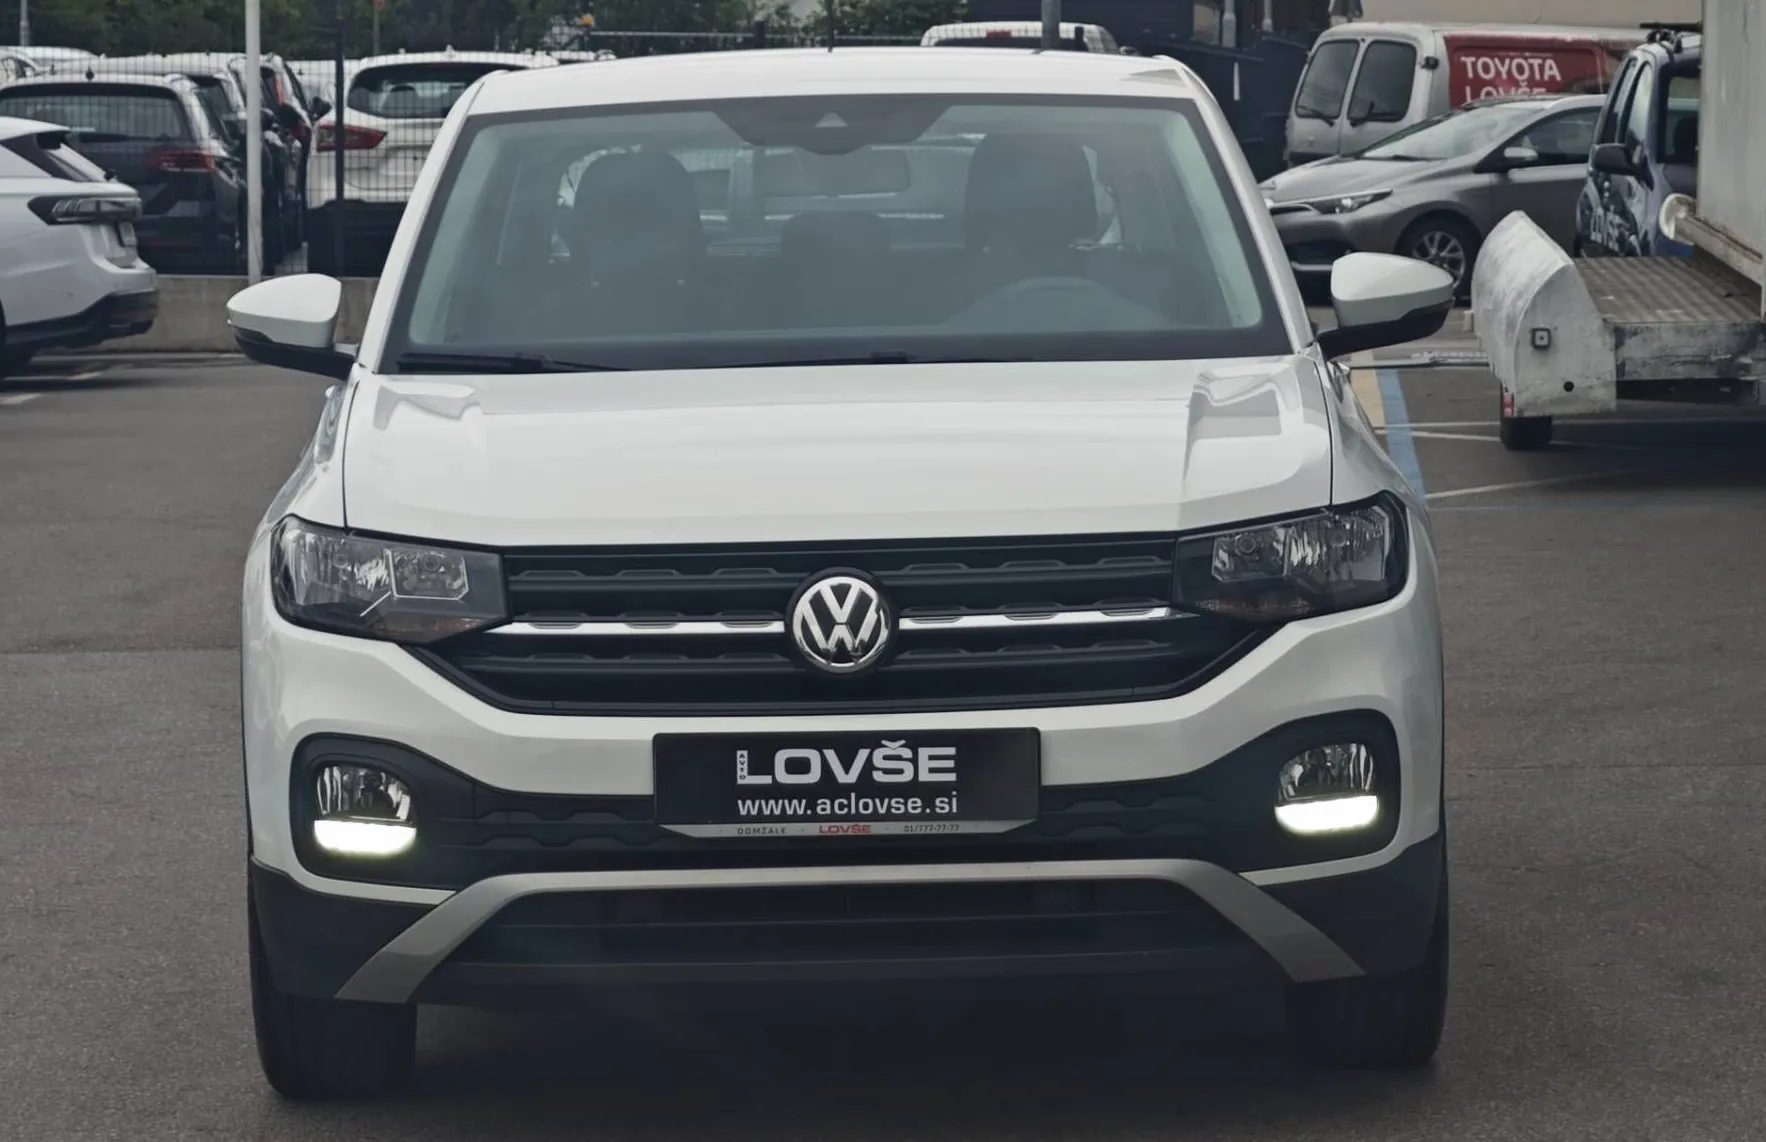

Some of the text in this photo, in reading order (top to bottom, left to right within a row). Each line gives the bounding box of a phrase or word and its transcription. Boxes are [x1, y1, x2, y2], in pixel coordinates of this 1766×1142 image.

[1460, 56, 1562, 81] TOYOTA
[736, 740, 957, 785] LOVŠE
[737, 791, 958, 816] www.aclovse.si
[737, 826, 787, 836] DOMŽALE
[819, 823, 872, 835] LOVŠE
